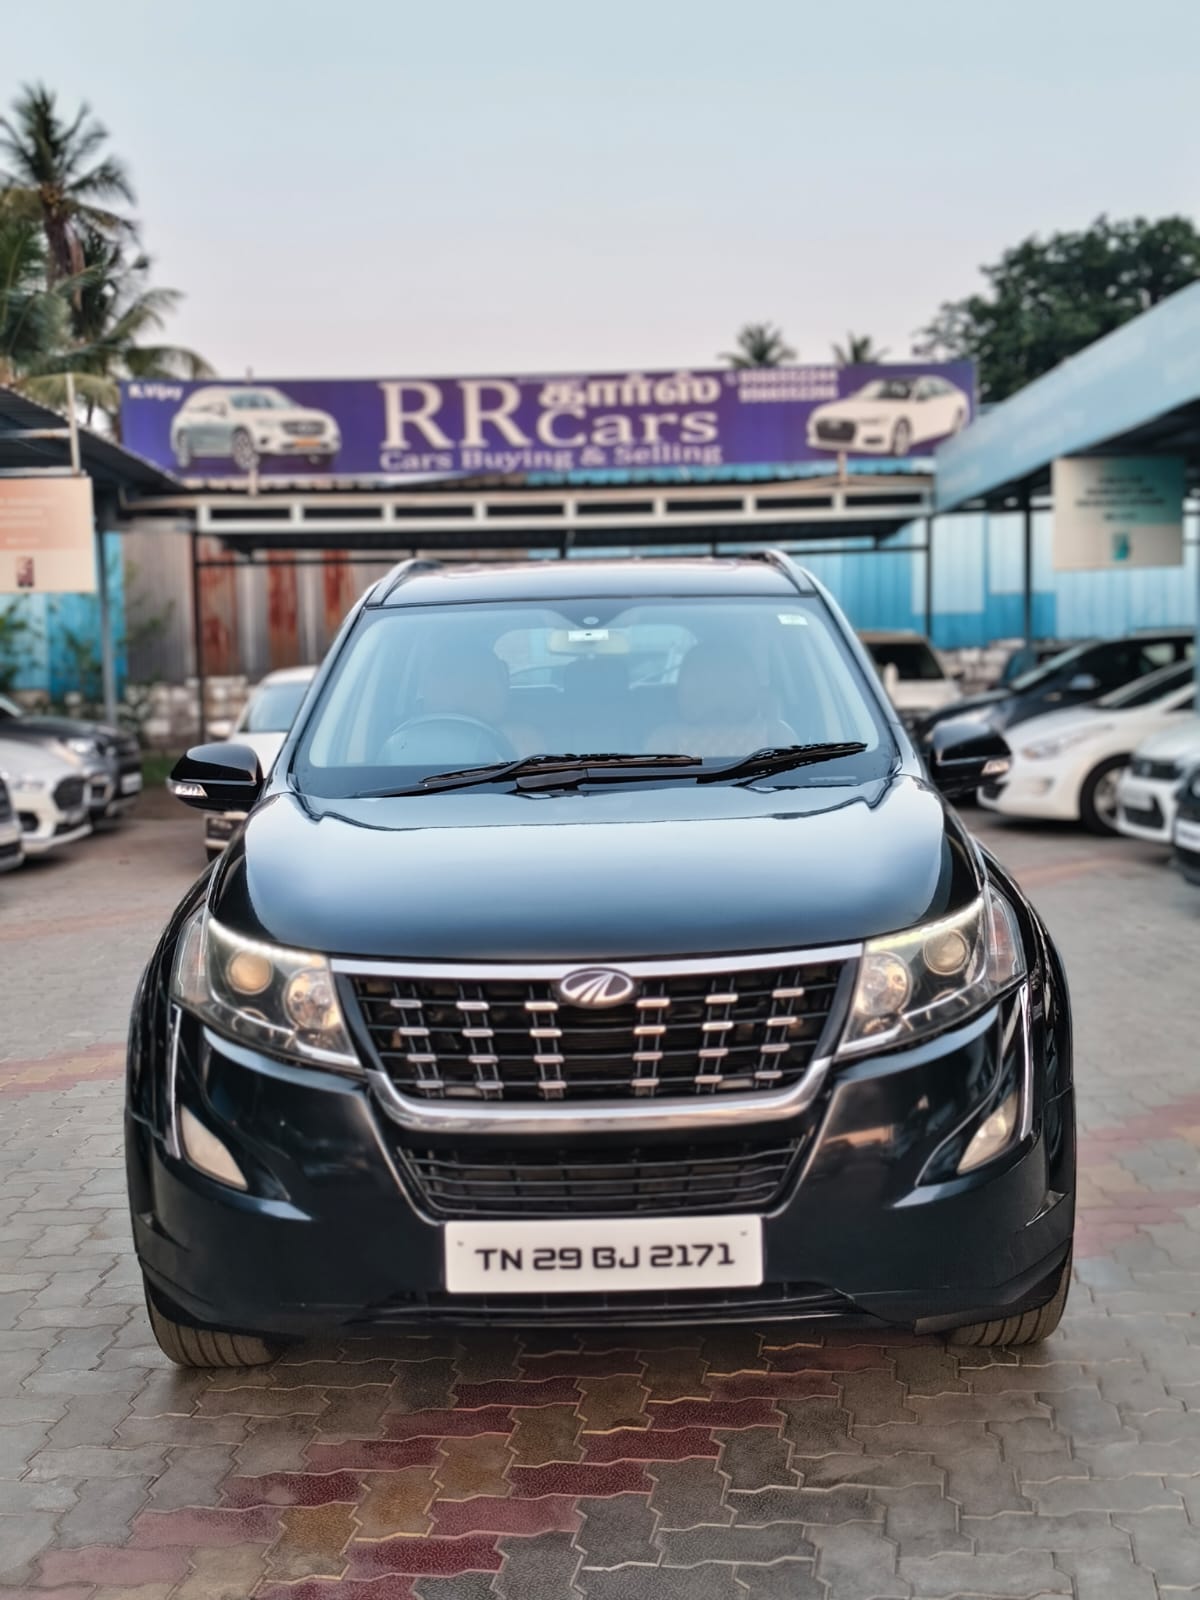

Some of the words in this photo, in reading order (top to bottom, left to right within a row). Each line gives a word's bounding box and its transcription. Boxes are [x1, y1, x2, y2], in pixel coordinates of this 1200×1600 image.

[537, 406, 718, 448] Cars
[380, 451, 453, 472] Cars
[461, 449, 574, 473] Buying
[580, 446, 606, 466] &
[613, 441, 723, 466] Selling
[475, 1248, 523, 1271] TN
[532, 1248, 582, 1270] 29
[591, 1246, 640, 1269] BJ
[650, 1243, 735, 1268] 2171
